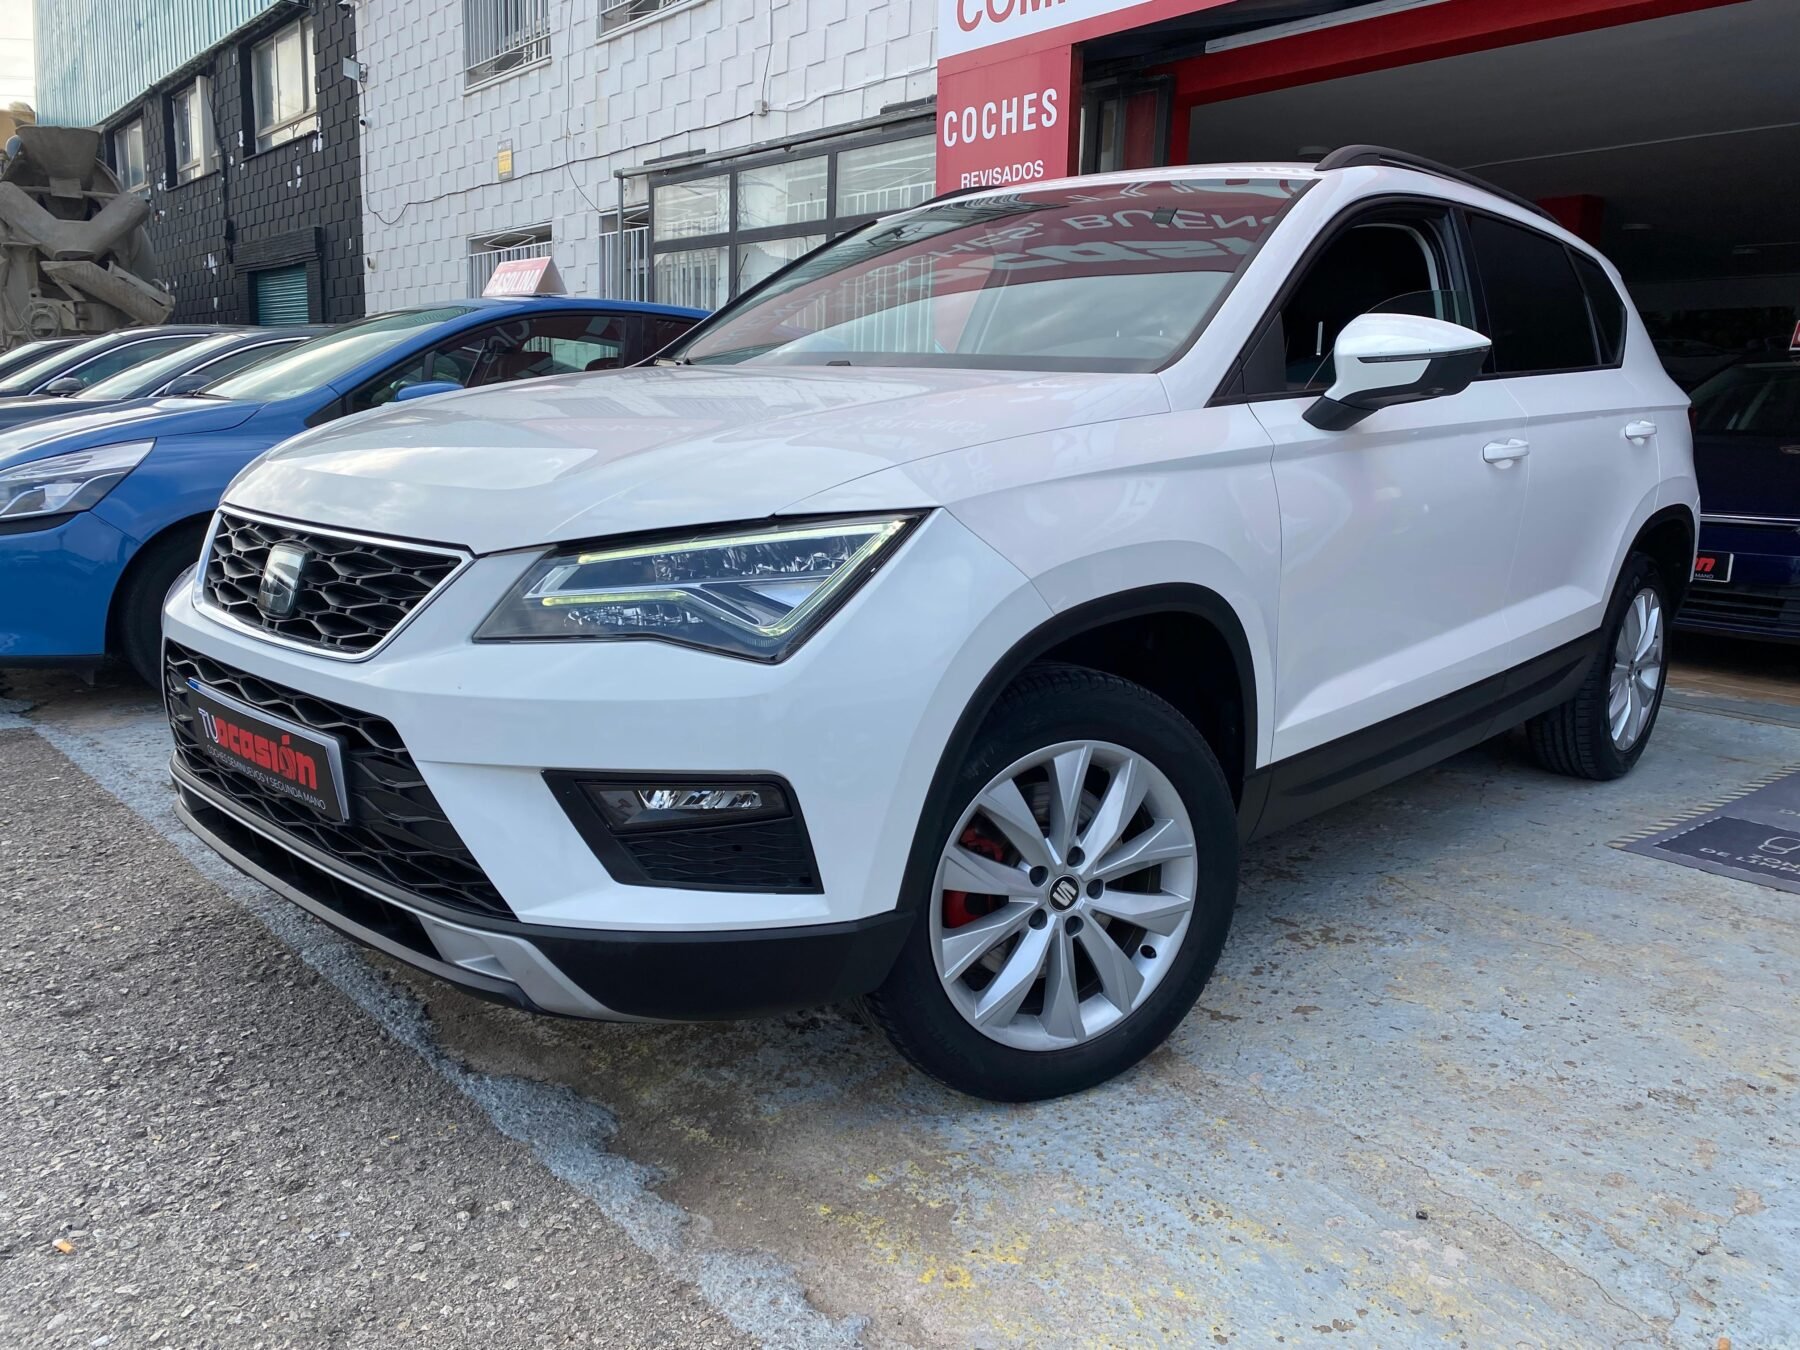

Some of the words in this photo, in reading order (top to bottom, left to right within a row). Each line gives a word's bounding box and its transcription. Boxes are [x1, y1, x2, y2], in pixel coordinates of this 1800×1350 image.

[943, 88, 1058, 147] COCHES
[960, 159, 1044, 189] REVISADOS
[302, 791, 326, 810] MANO
[1699, 847, 1731, 858] DE
